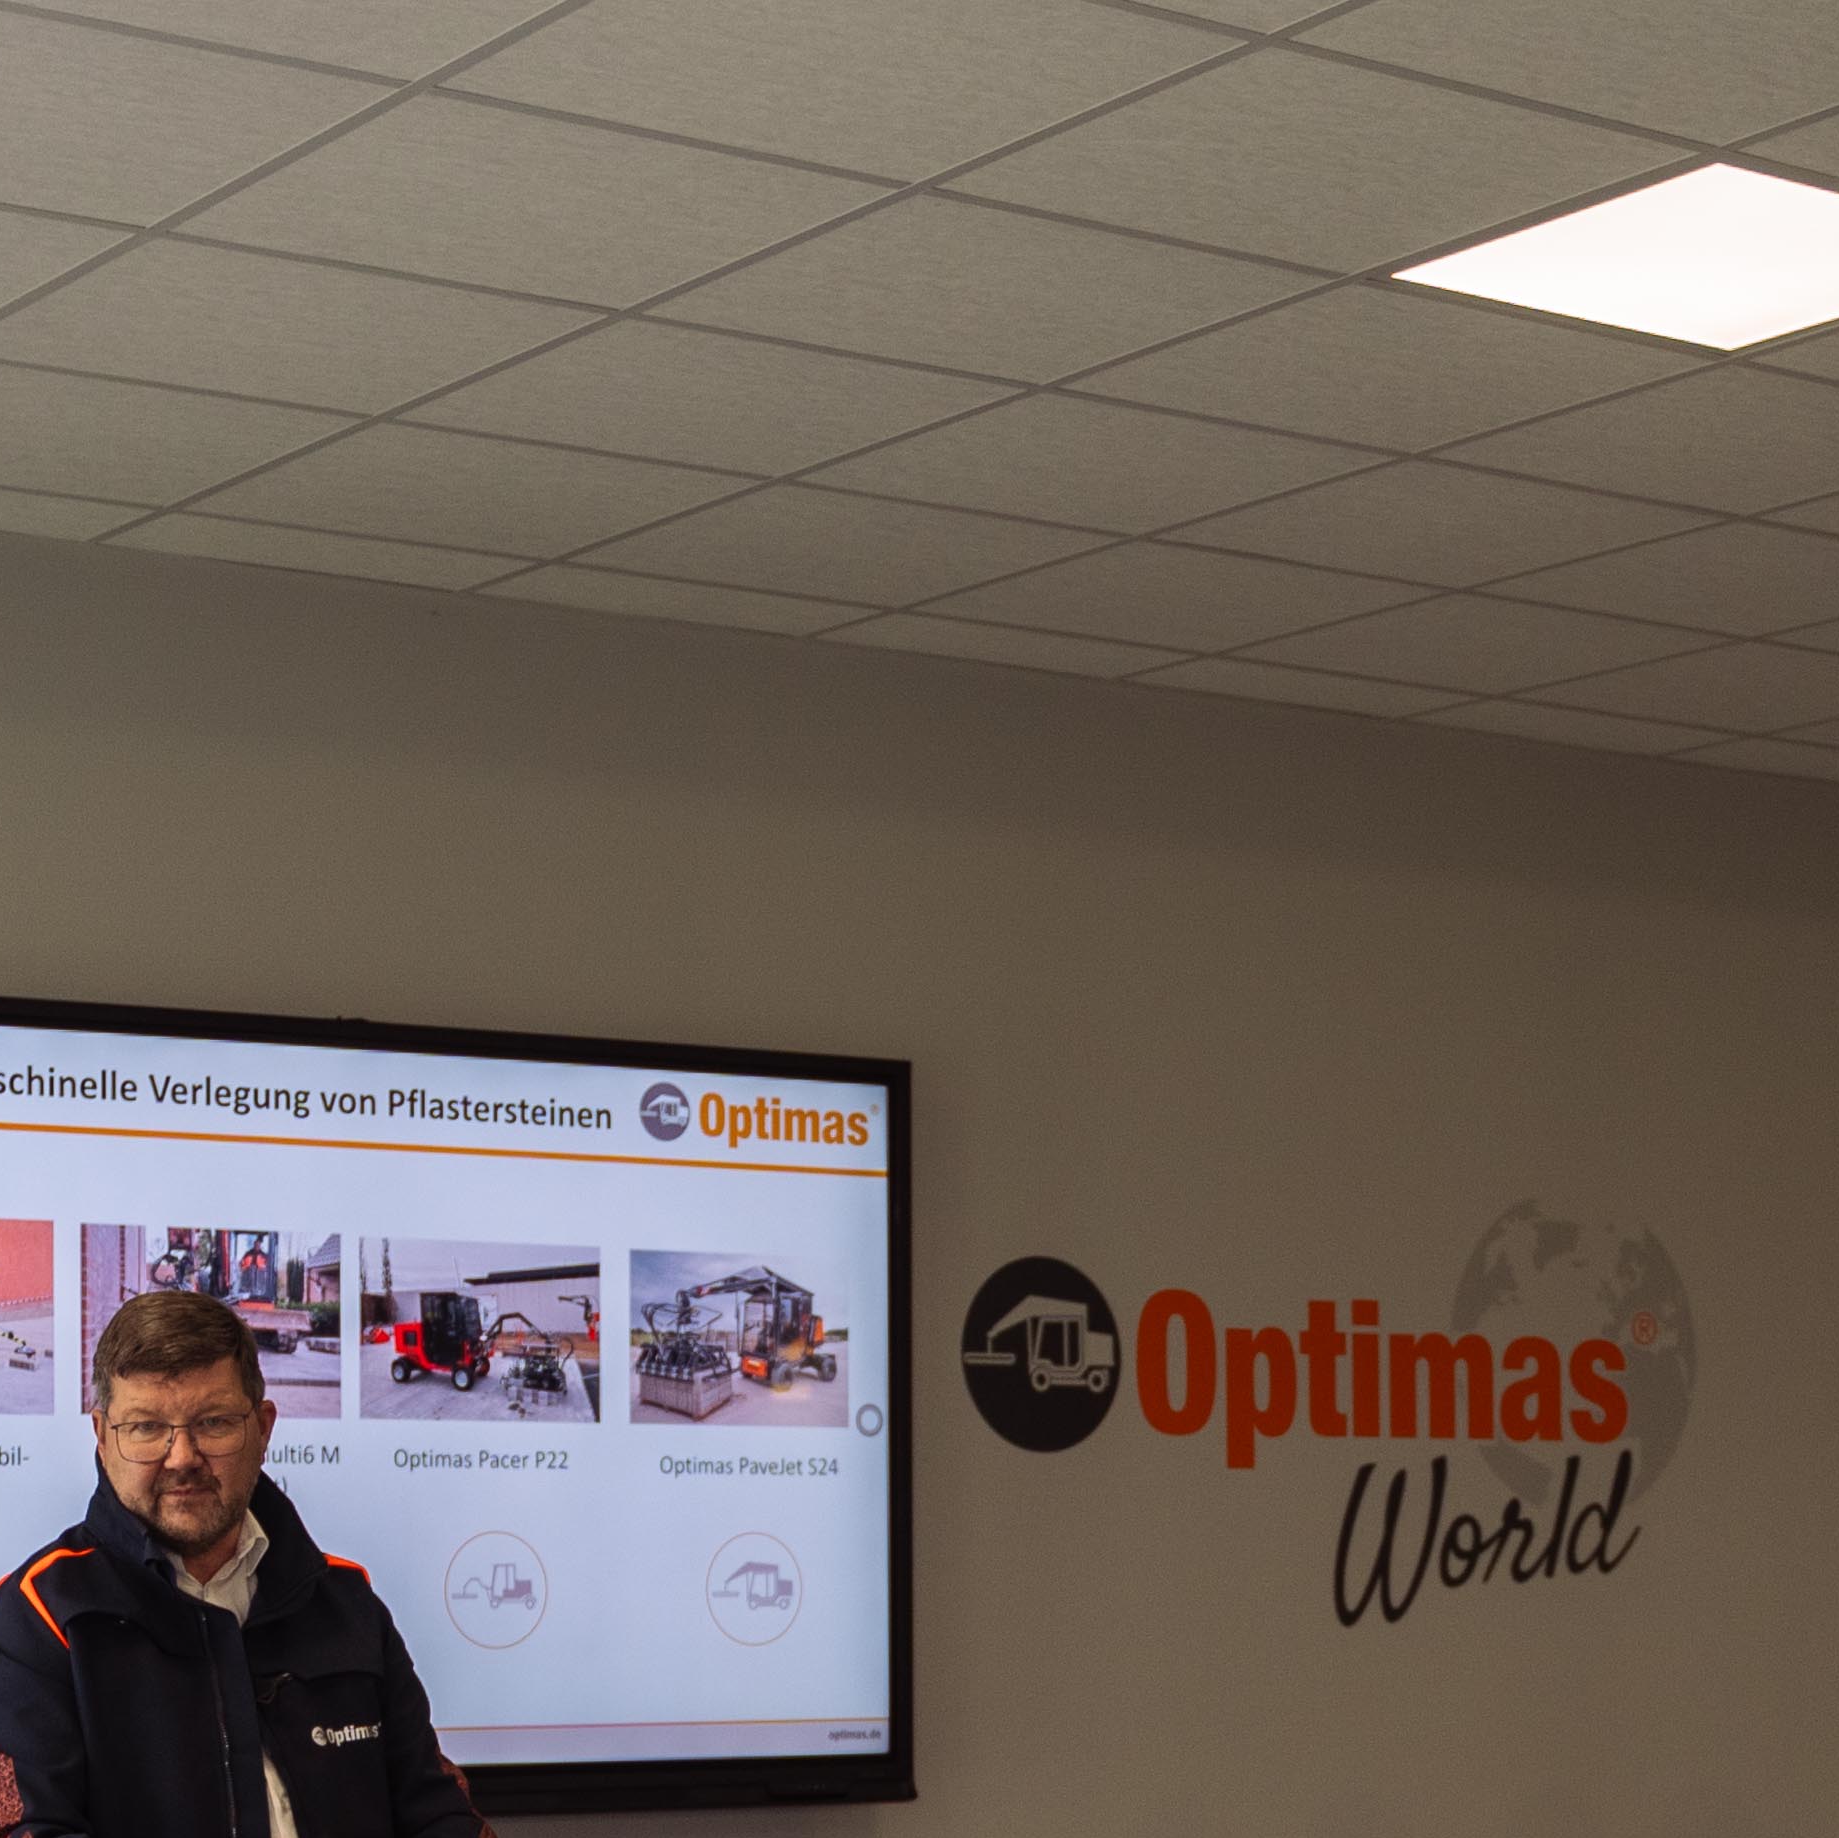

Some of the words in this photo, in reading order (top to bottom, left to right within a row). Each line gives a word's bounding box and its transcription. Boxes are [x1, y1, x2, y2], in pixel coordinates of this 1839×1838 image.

[148, 1073, 311, 1119] Verlegung
[320, 1091, 377, 1116] von
[388, 1088, 613, 1130] Pflastersteinen
[264, 1444, 315, 1465] ulti6
[321, 1445, 340, 1465] M
[393, 1447, 472, 1472] Optimas
[478, 1450, 529, 1470] Pacer
[535, 1450, 569, 1470] P22
[659, 1455, 734, 1479] Optimas
[739, 1456, 804, 1476] PaveJet
[808, 1457, 839, 1476] S24
[1333, 1449, 1643, 1628] World
[326, 1725, 379, 1747] Optims
